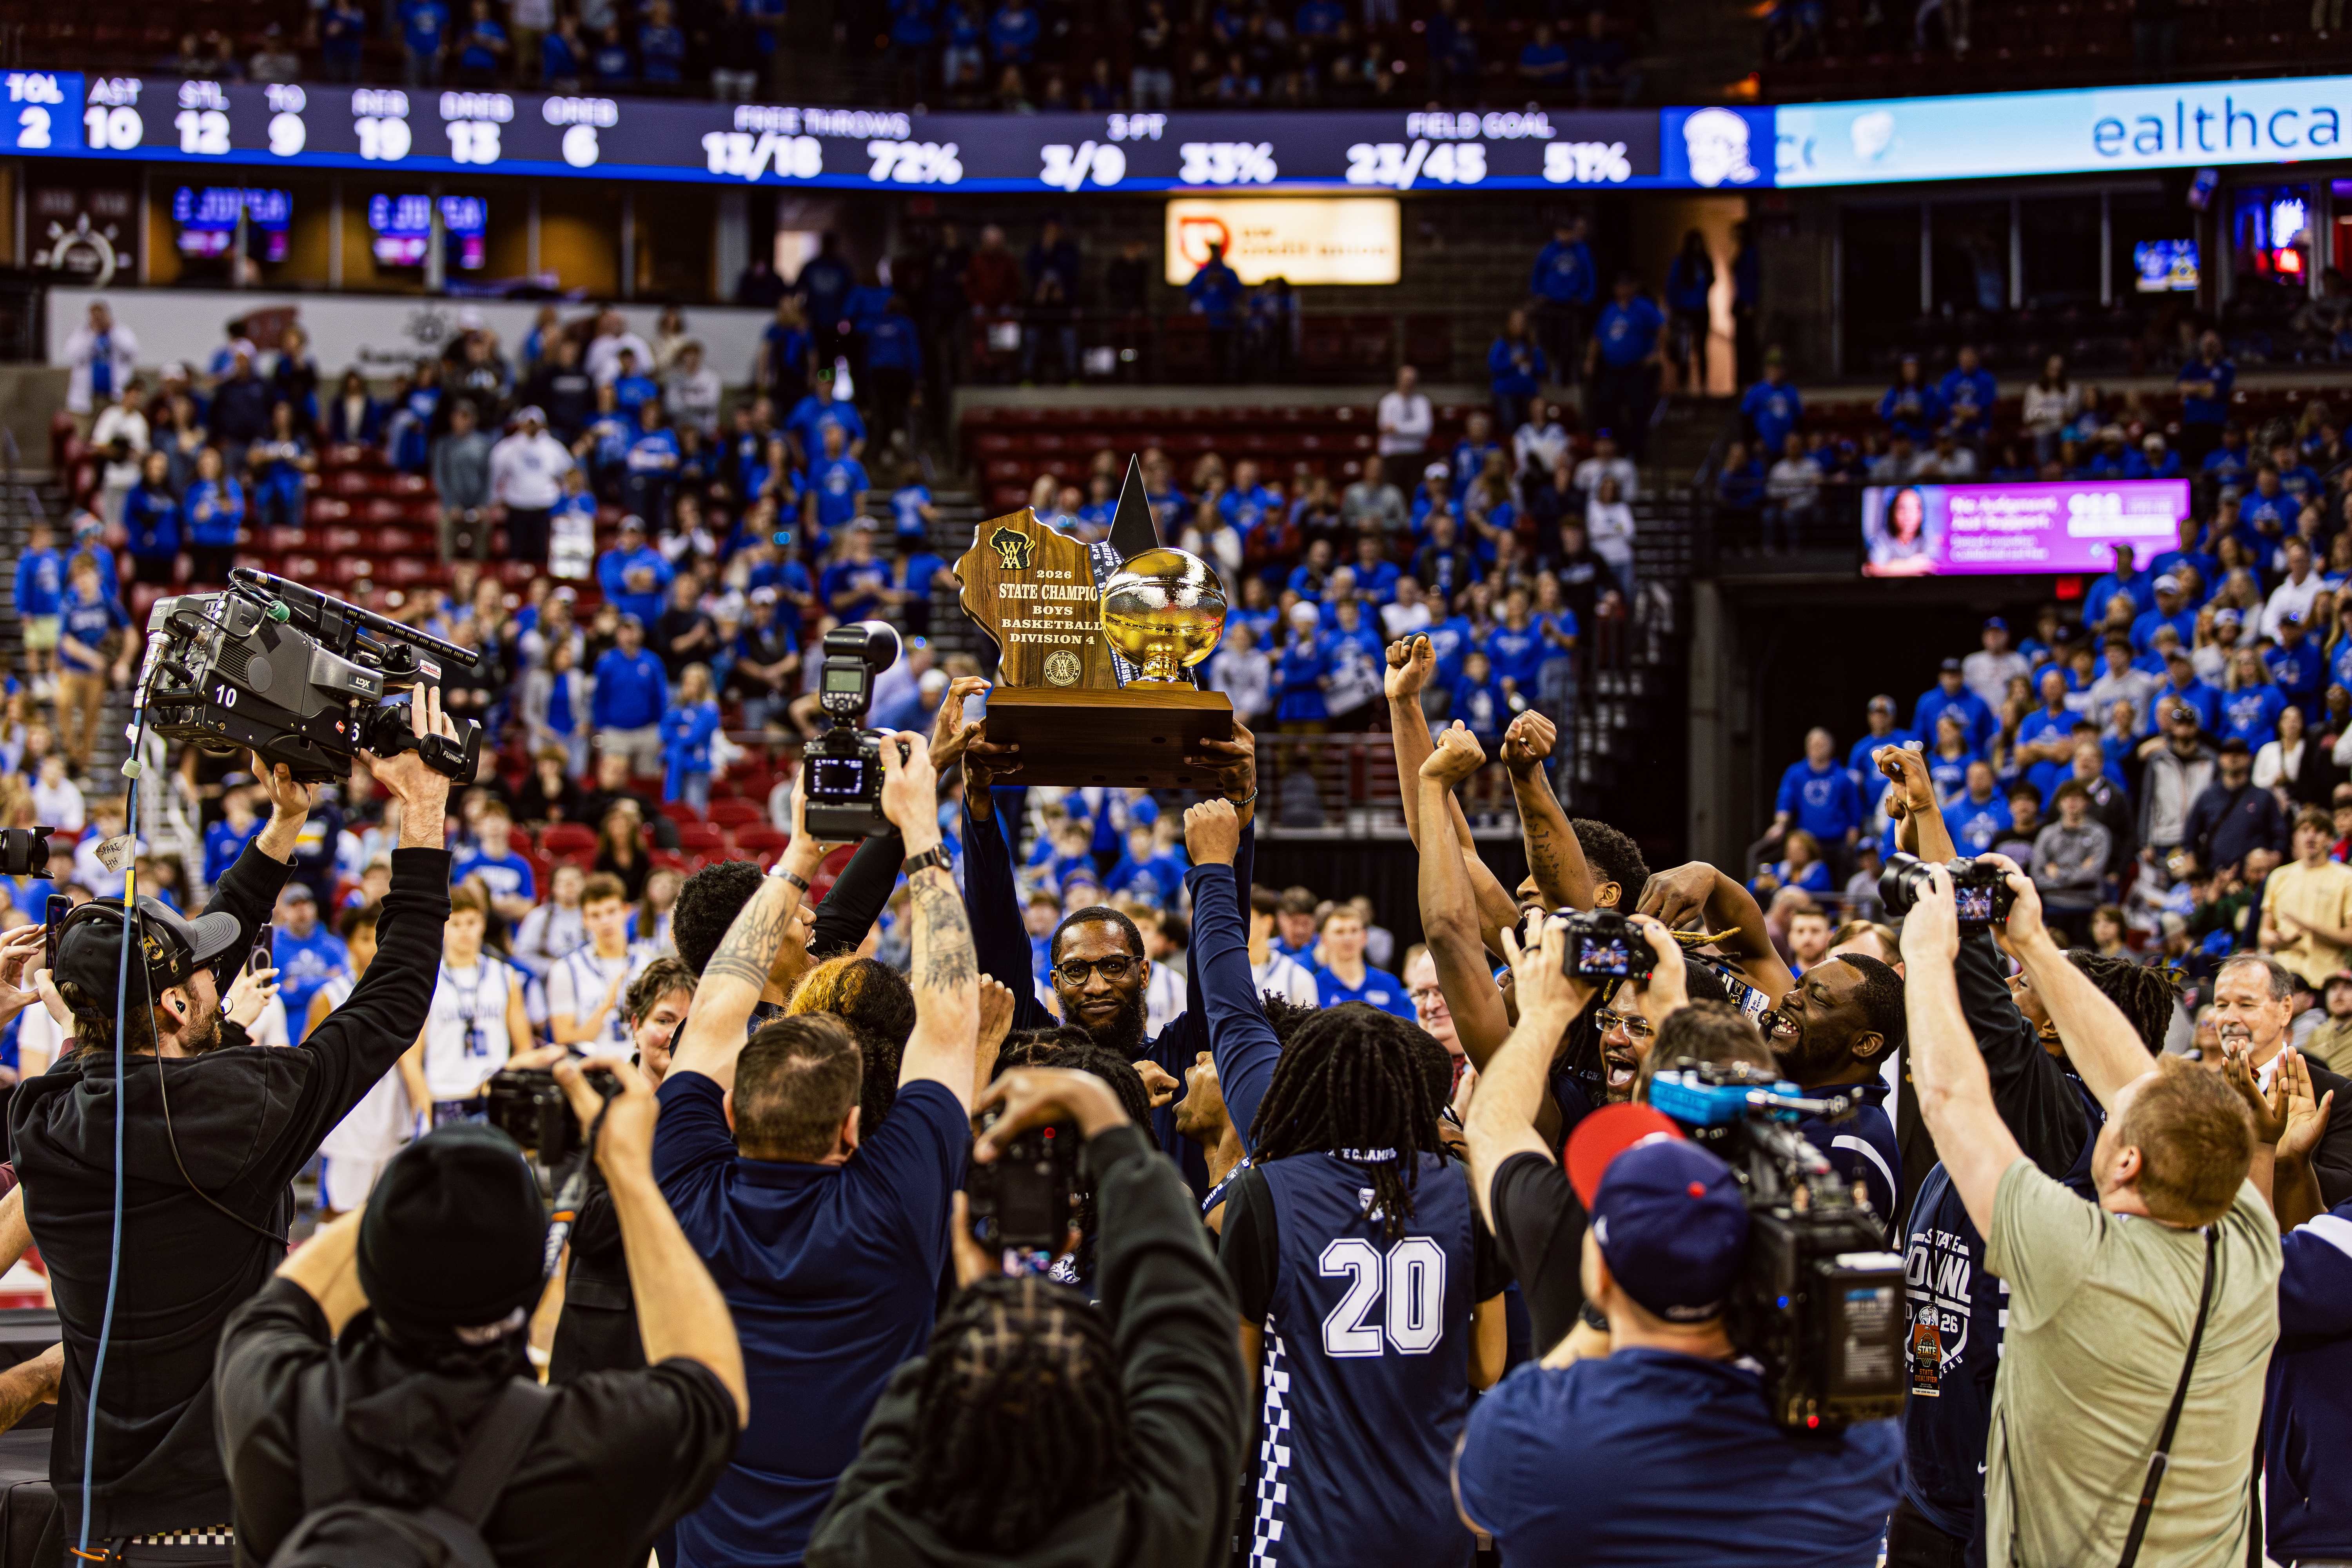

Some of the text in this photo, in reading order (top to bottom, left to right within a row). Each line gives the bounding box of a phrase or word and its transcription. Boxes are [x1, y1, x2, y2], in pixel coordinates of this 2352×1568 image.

[5, 73, 64, 104] TOL
[88, 77, 143, 105] AST
[178, 80, 230, 111] STL
[264, 83, 307, 113] TO
[17, 106, 51, 149] 2
[83, 105, 143, 150] 10
[174, 110, 231, 155] 12
[268, 113, 306, 157] 9
[734, 105, 911, 140] FREE THROWS
[1406, 112, 1557, 139] FIELD GOAL
[562, 124, 599, 168] 6
[867, 140, 963, 185] 72%
[1040, 140, 1126, 192] 3/9
[1179, 142, 1278, 184] 33%
[1346, 139, 1487, 191] 23/45
[1543, 141, 1631, 183] 51%
[1037, 570, 1072, 579] 2026
[999, 583, 1038, 599] STATE
[1041, 584, 1098, 602] CHAMPIO
[1033, 605, 1073, 615] BOYS
[1001, 619, 1103, 631] BASKETBALL
[1009, 633, 1095, 645] DIVISION 4
[1046, 653, 1058, 670] CITIZENSHIP
[1067, 654, 1079, 670] CHARACTER
[356, 677, 371, 688] LDX
[1049, 677, 1074, 686] SPORTSMANSHIP
[216, 684, 237, 708] 10
[443, 750, 463, 764] FUJINON
[96, 842, 122, 855] SPARE
[105, 857, 118, 869] HH
[1202, 1183, 1223, 1210] SHIPS
[1318, 1236, 1446, 1357] 20
[1940, 1313, 1958, 1333] 26
[1918, 1345, 1936, 1356] STATE
[1915, 1375, 1938, 1383] QUALIFIER
